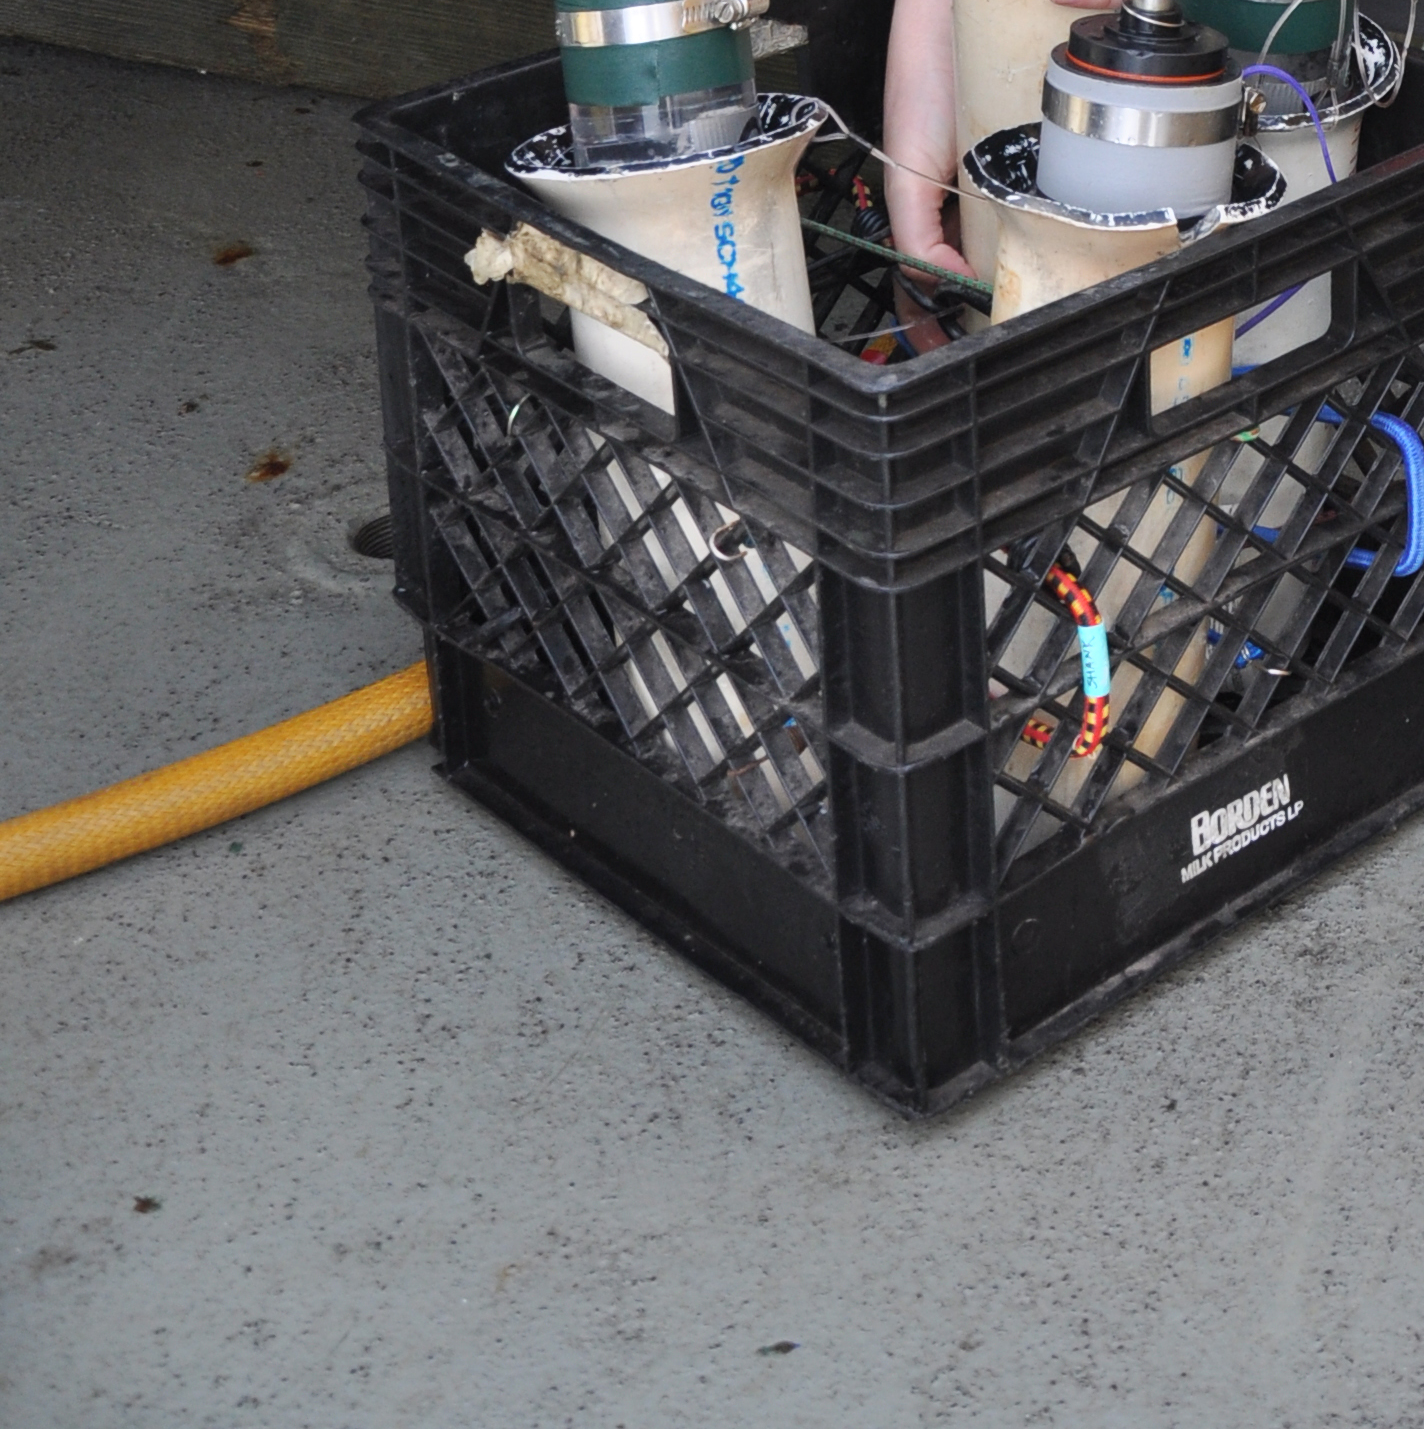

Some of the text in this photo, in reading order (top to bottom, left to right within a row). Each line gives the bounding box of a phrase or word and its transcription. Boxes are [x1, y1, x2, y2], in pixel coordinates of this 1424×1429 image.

[1181, 799, 1305, 884] MILK PRODUCTS LP
[1190, 773, 1291, 857] BORDEN
